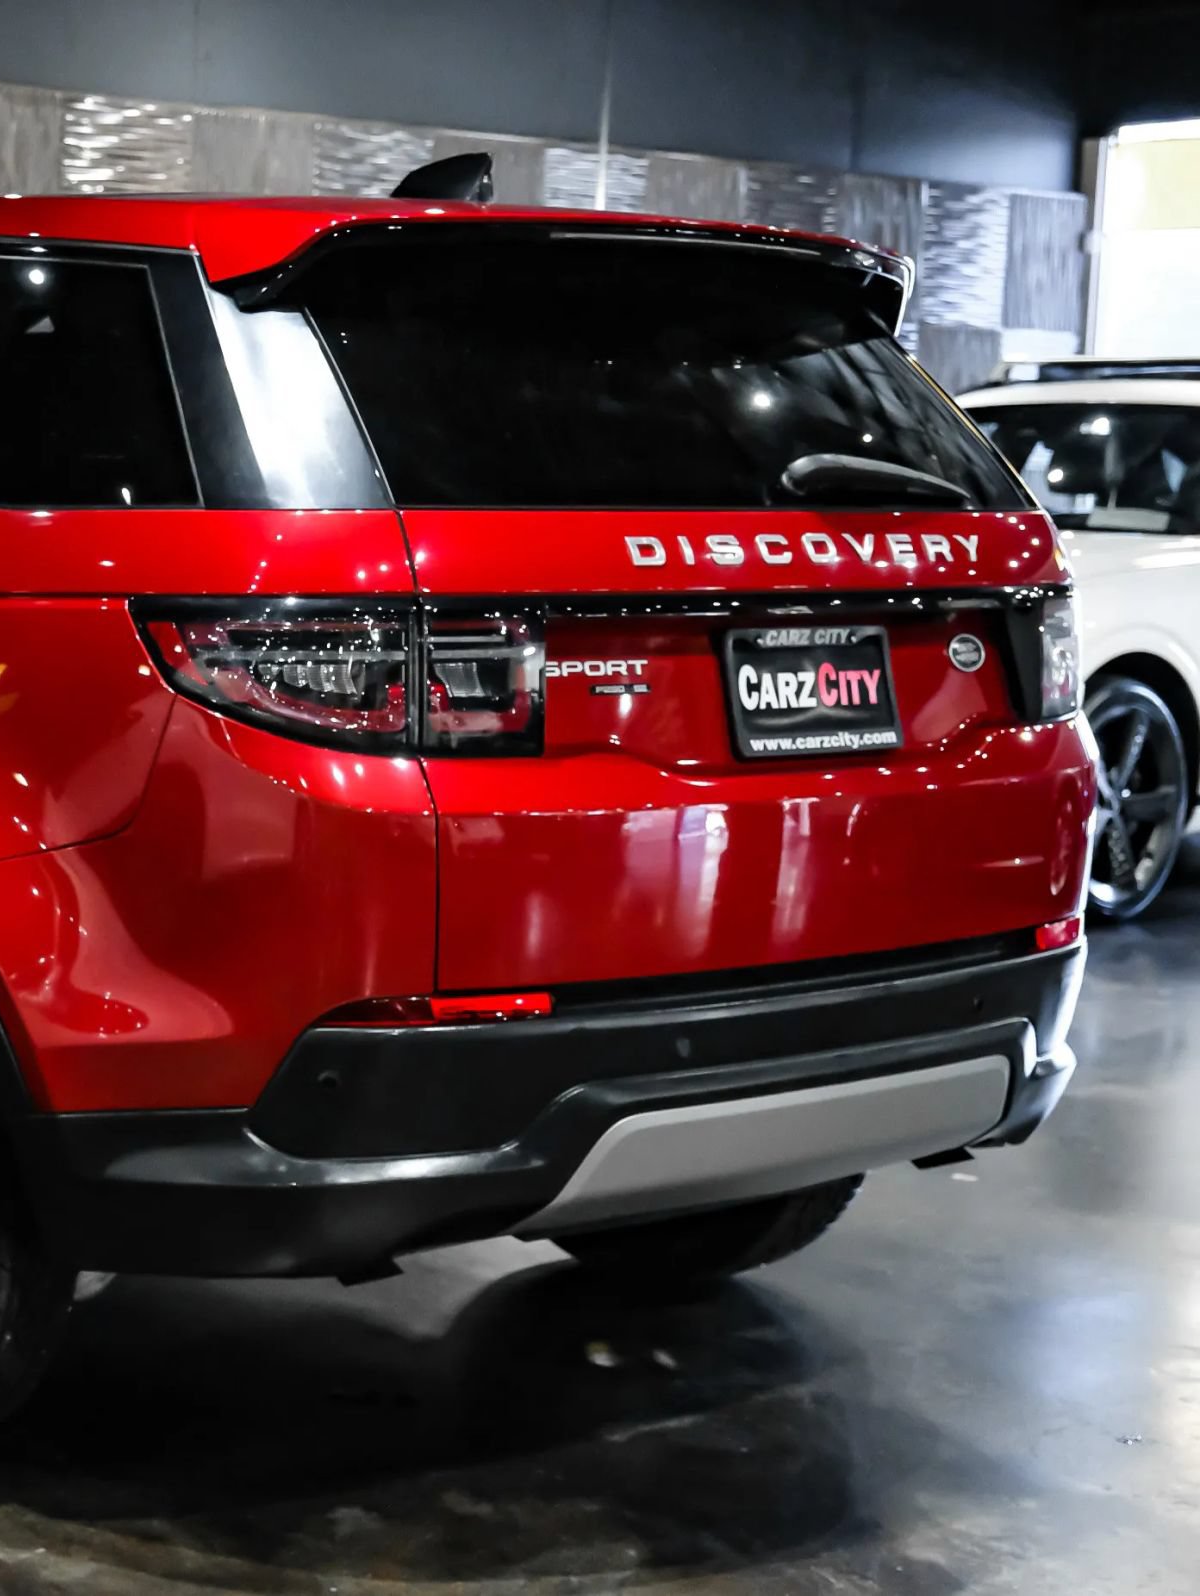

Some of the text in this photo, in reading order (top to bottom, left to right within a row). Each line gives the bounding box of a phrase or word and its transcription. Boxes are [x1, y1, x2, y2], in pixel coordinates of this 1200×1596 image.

[624, 532, 979, 566] DISCOVERY
[765, 628, 851, 646] CARZ CITY
[545, 659, 649, 677] SPORT
[750, 731, 897, 751] www.carzcity.com
